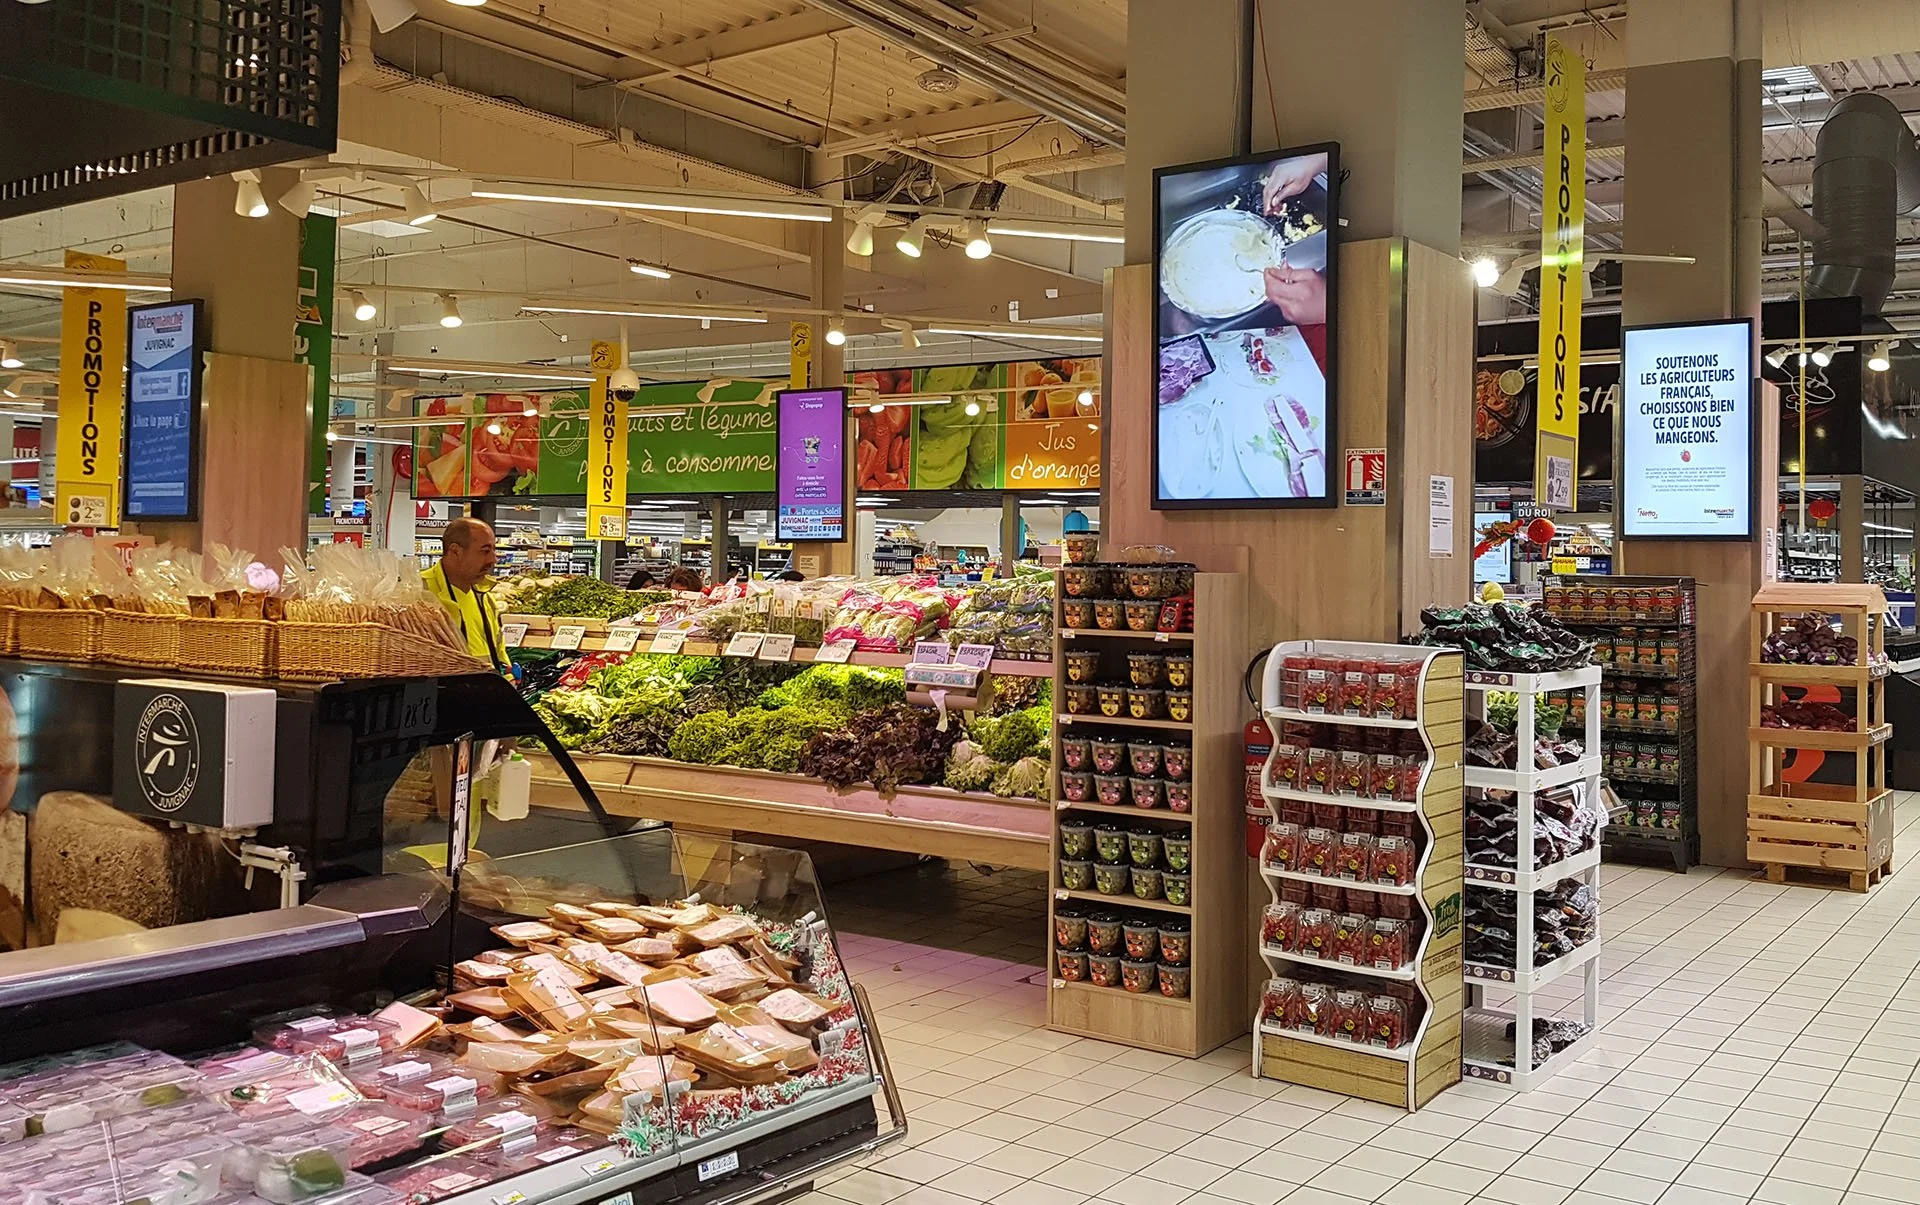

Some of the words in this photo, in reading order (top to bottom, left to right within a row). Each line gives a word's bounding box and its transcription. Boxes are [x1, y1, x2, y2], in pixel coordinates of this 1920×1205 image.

[1554, 124, 1570, 423] PROMOTIONS
[144, 337, 175, 351] JUVIGNAC
[1656, 354, 1718, 369] SOUTENONS
[1640, 372, 1658, 385] LES
[1660, 368, 1735, 384] AGRICULTEURS
[82, 301, 102, 475] PROMOTIONS
[1660, 385, 1714, 399] FRANÇAIS,
[1640, 400, 1707, 415] CHOISISSONS
[1710, 399, 1735, 412] BIEN
[670, 410, 694, 431] et
[701, 404, 776, 439] légume
[1653, 417, 1665, 429] CE
[1668, 416, 1690, 430] QUE
[1692, 415, 1721, 428] NOUS
[1038, 423, 1076, 451] Jus
[1655, 430, 1718, 444] MANGEONS.
[641, 449, 655, 474] à
[1010, 453, 1101, 486] d'orange
[781, 516, 808, 524] JUVIGNAC
[1518, 508, 1531, 517] DU
[1534, 508, 1551, 517] ROI
[335, 517, 364, 525] PROMOTIONS
[416, 519, 450, 528] PROMOTION
[158, 776, 193, 808] JUVIGNAC
